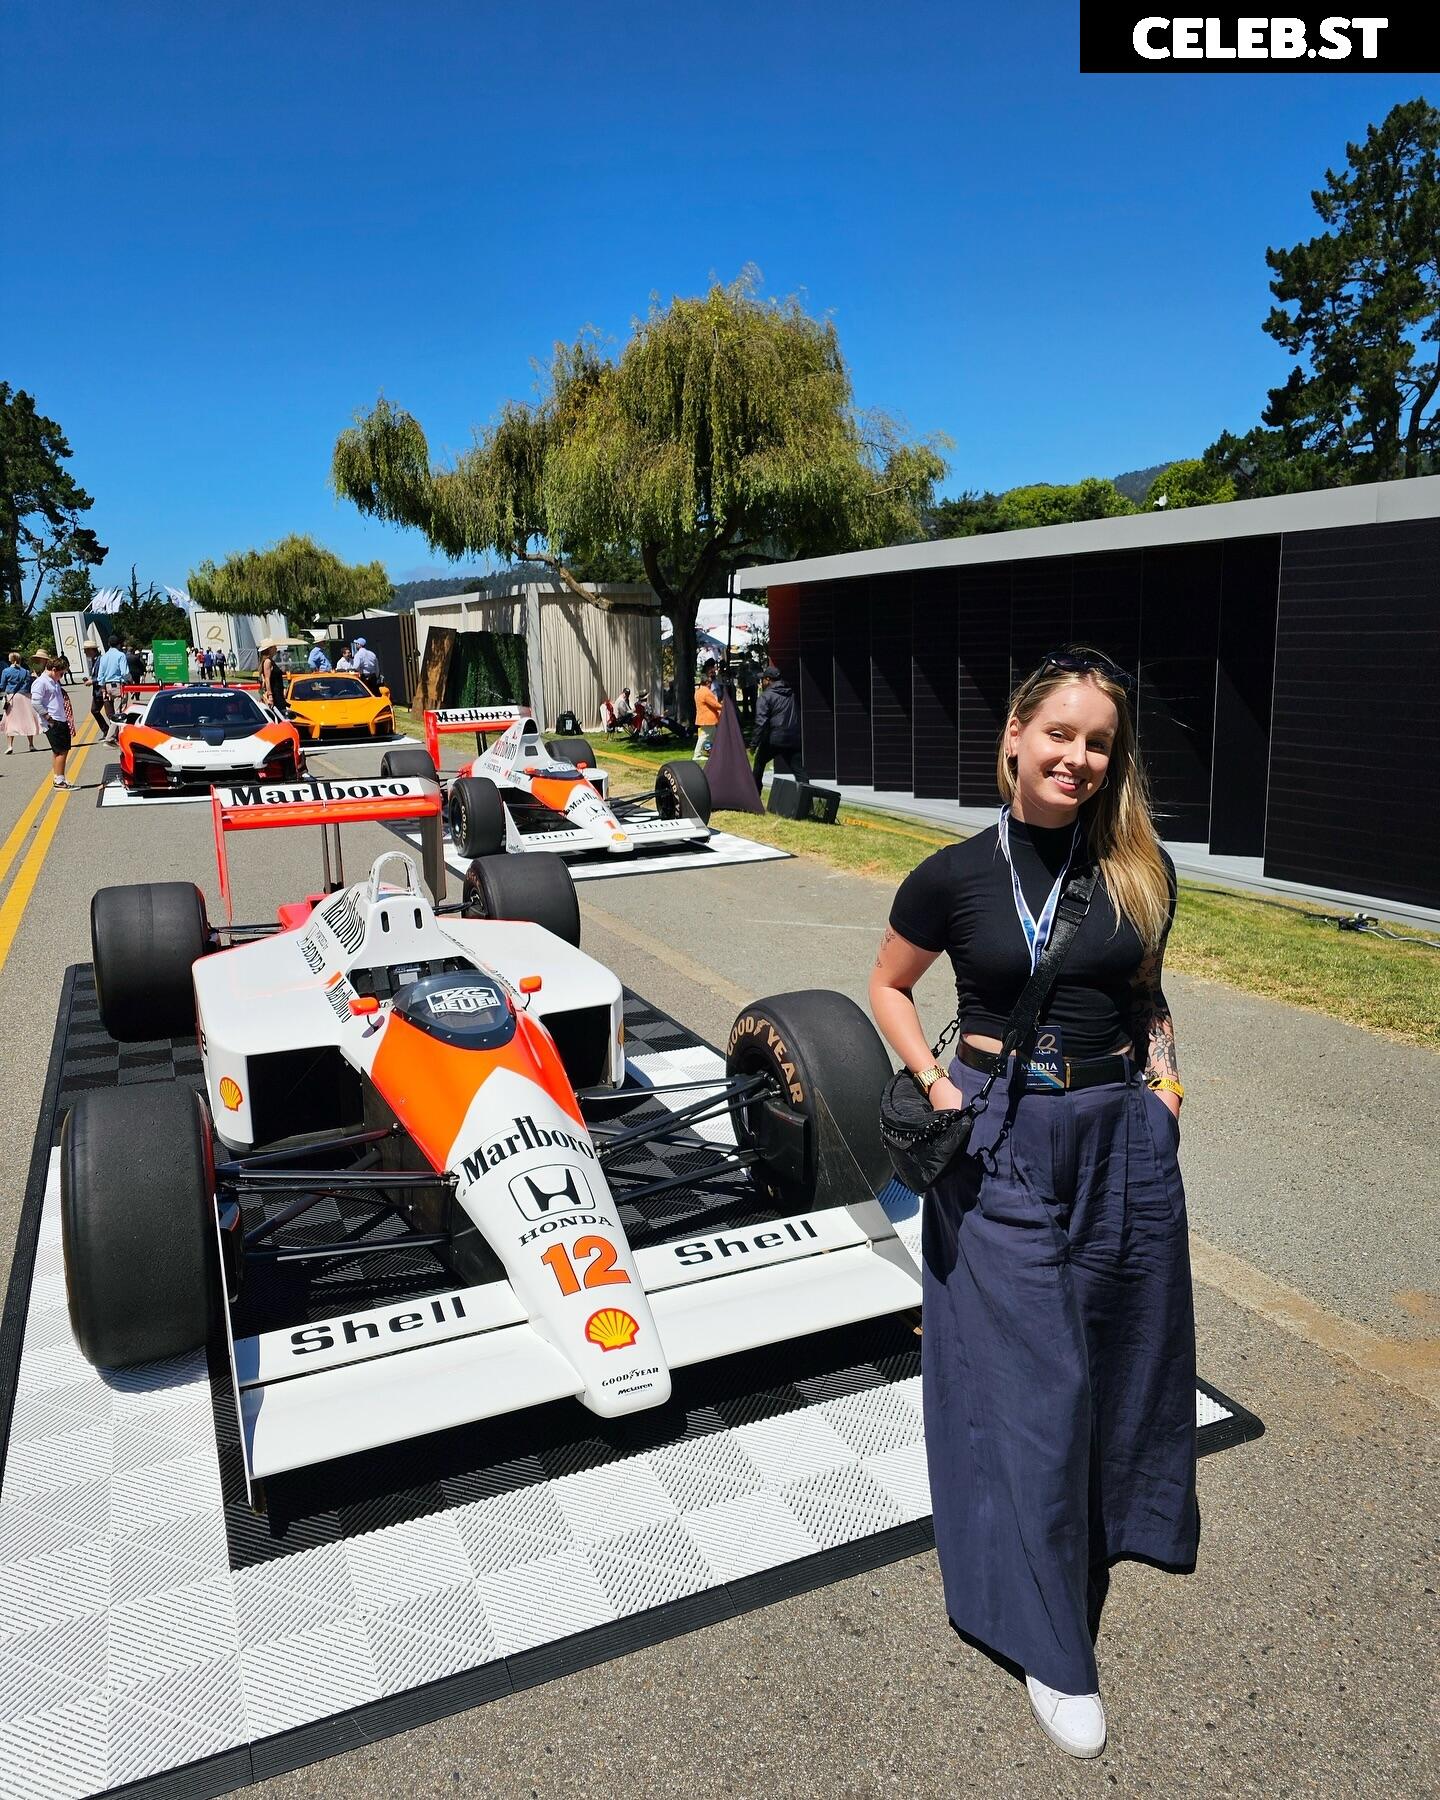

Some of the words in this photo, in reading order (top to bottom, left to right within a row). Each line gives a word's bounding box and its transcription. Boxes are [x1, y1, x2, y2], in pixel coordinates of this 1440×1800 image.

[435, 709, 512, 722] Marlboro
[229, 782, 410, 807] Marlboro
[1021, 1062, 1058, 1071] MEDIA
[460, 1115, 595, 1187] Marlboro
[518, 1215, 615, 1247] HONDA
[674, 1220, 818, 1266] Shell
[540, 1235, 632, 1297] 12
[290, 1295, 467, 1356] Shell
